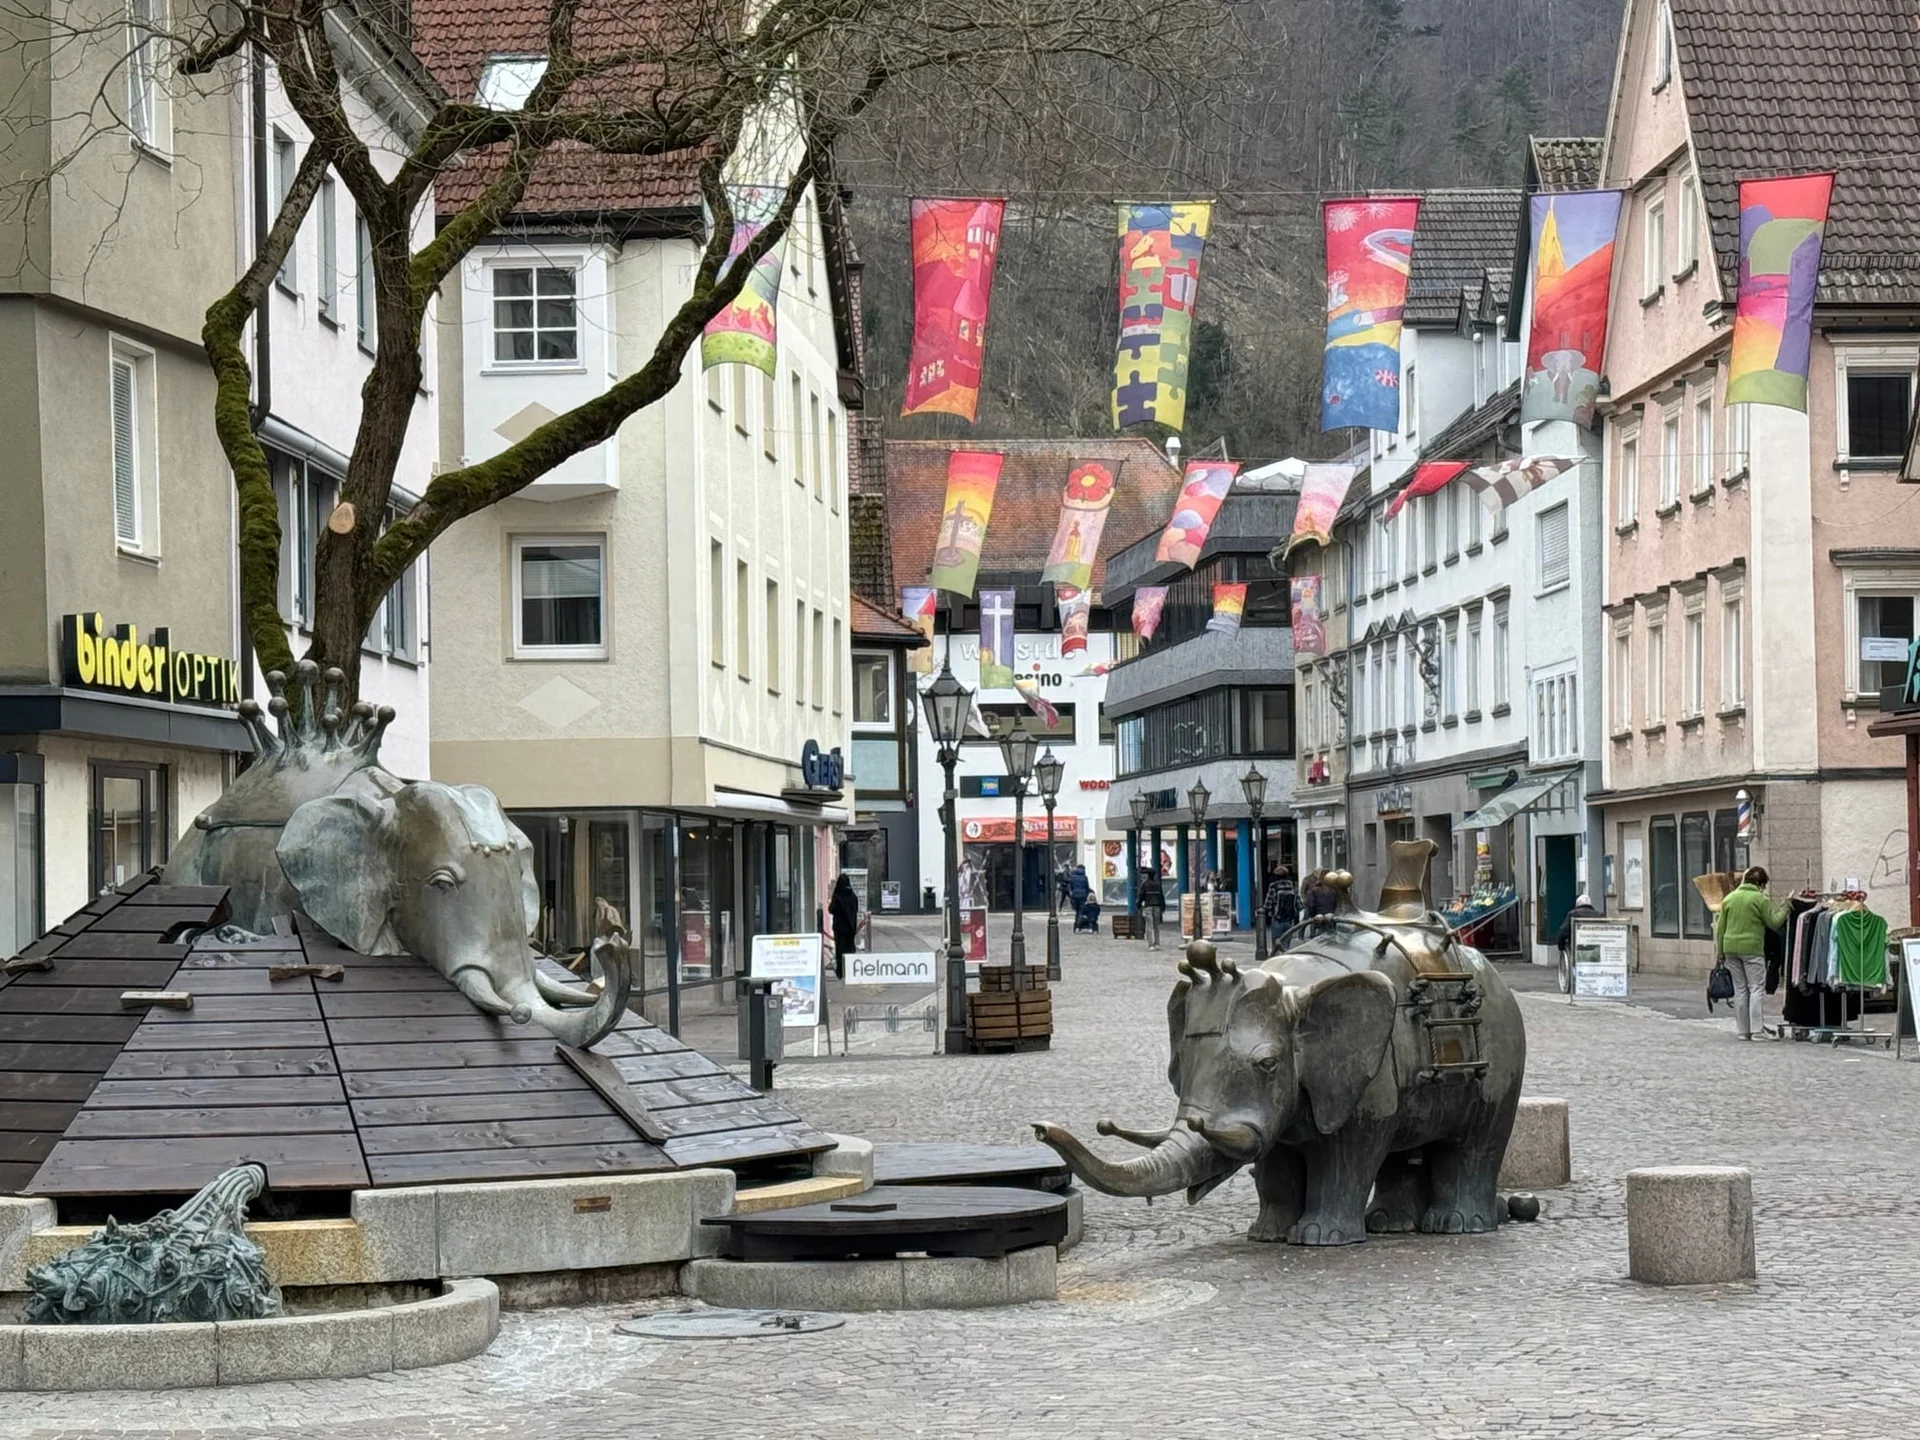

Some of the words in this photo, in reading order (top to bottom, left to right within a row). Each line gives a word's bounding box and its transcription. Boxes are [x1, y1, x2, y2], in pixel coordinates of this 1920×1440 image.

[76, 612, 166, 693] binder
[175, 650, 242, 703] OPTIK
[852, 958, 928, 978] fielmann
